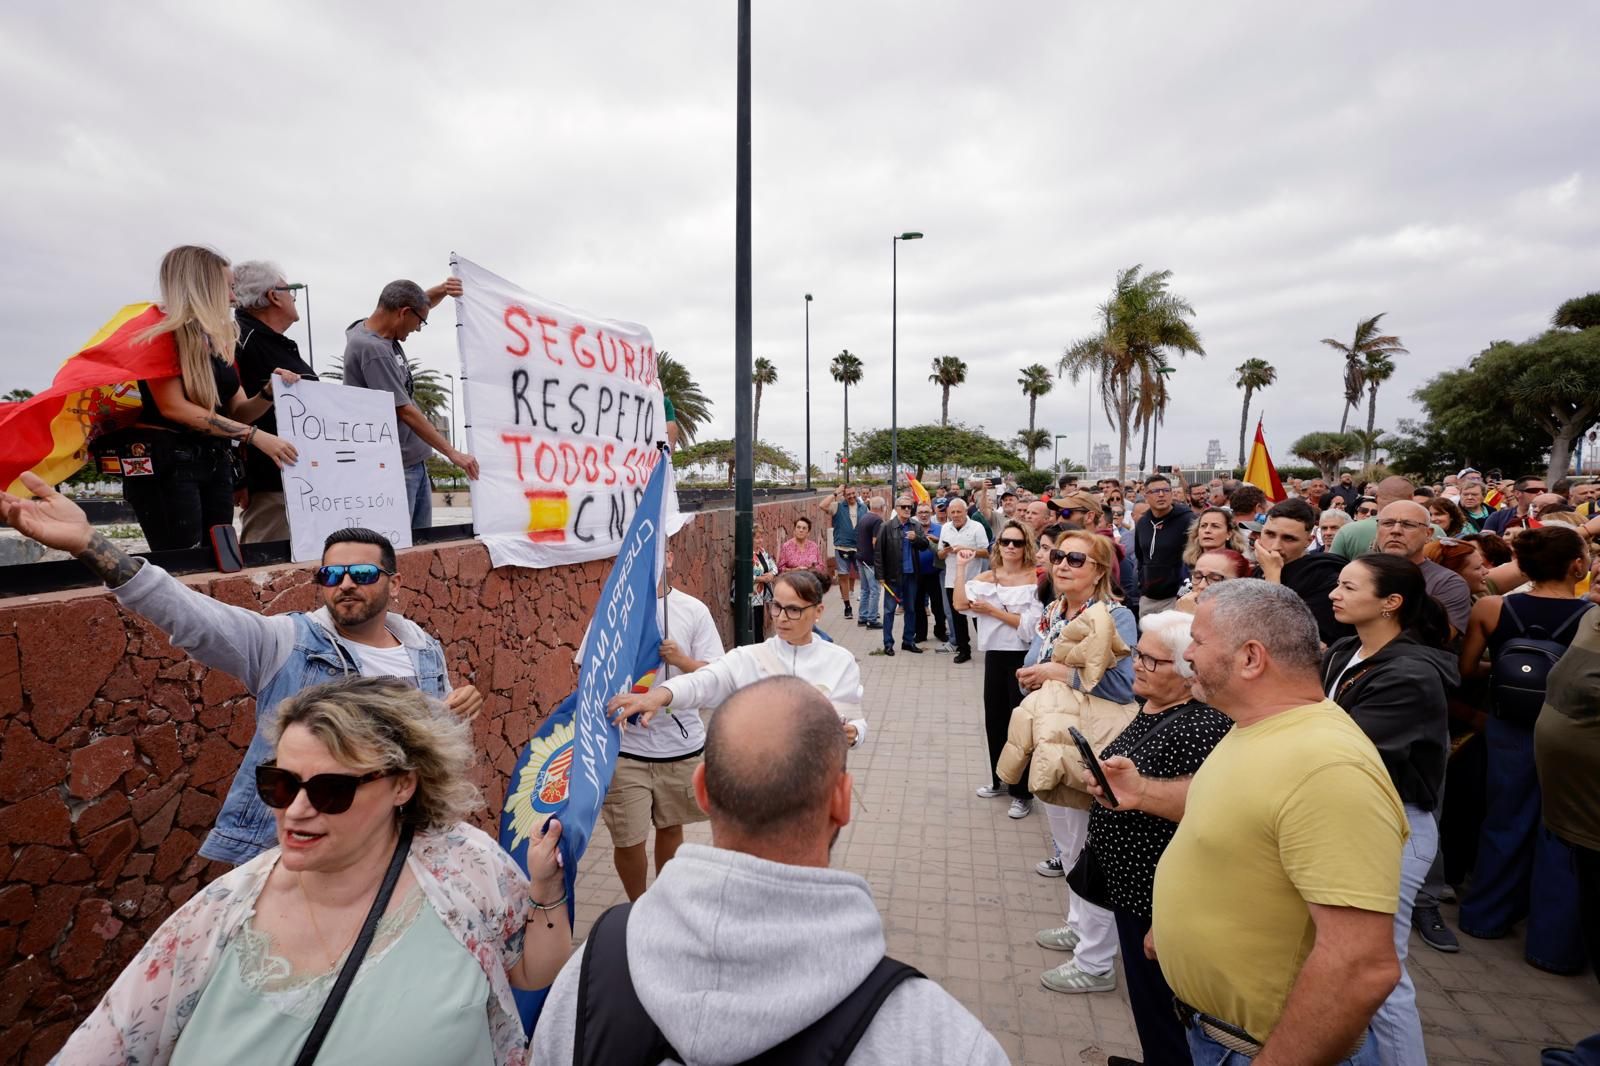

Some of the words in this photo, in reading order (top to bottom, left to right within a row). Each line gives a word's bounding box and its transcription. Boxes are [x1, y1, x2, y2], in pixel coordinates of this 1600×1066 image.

[280, 393, 393, 445] POLICIA
[512, 368, 654, 446] RESPETO
[501, 433, 617, 486] TODOS
[291, 476, 394, 513] PROFESIÓN
